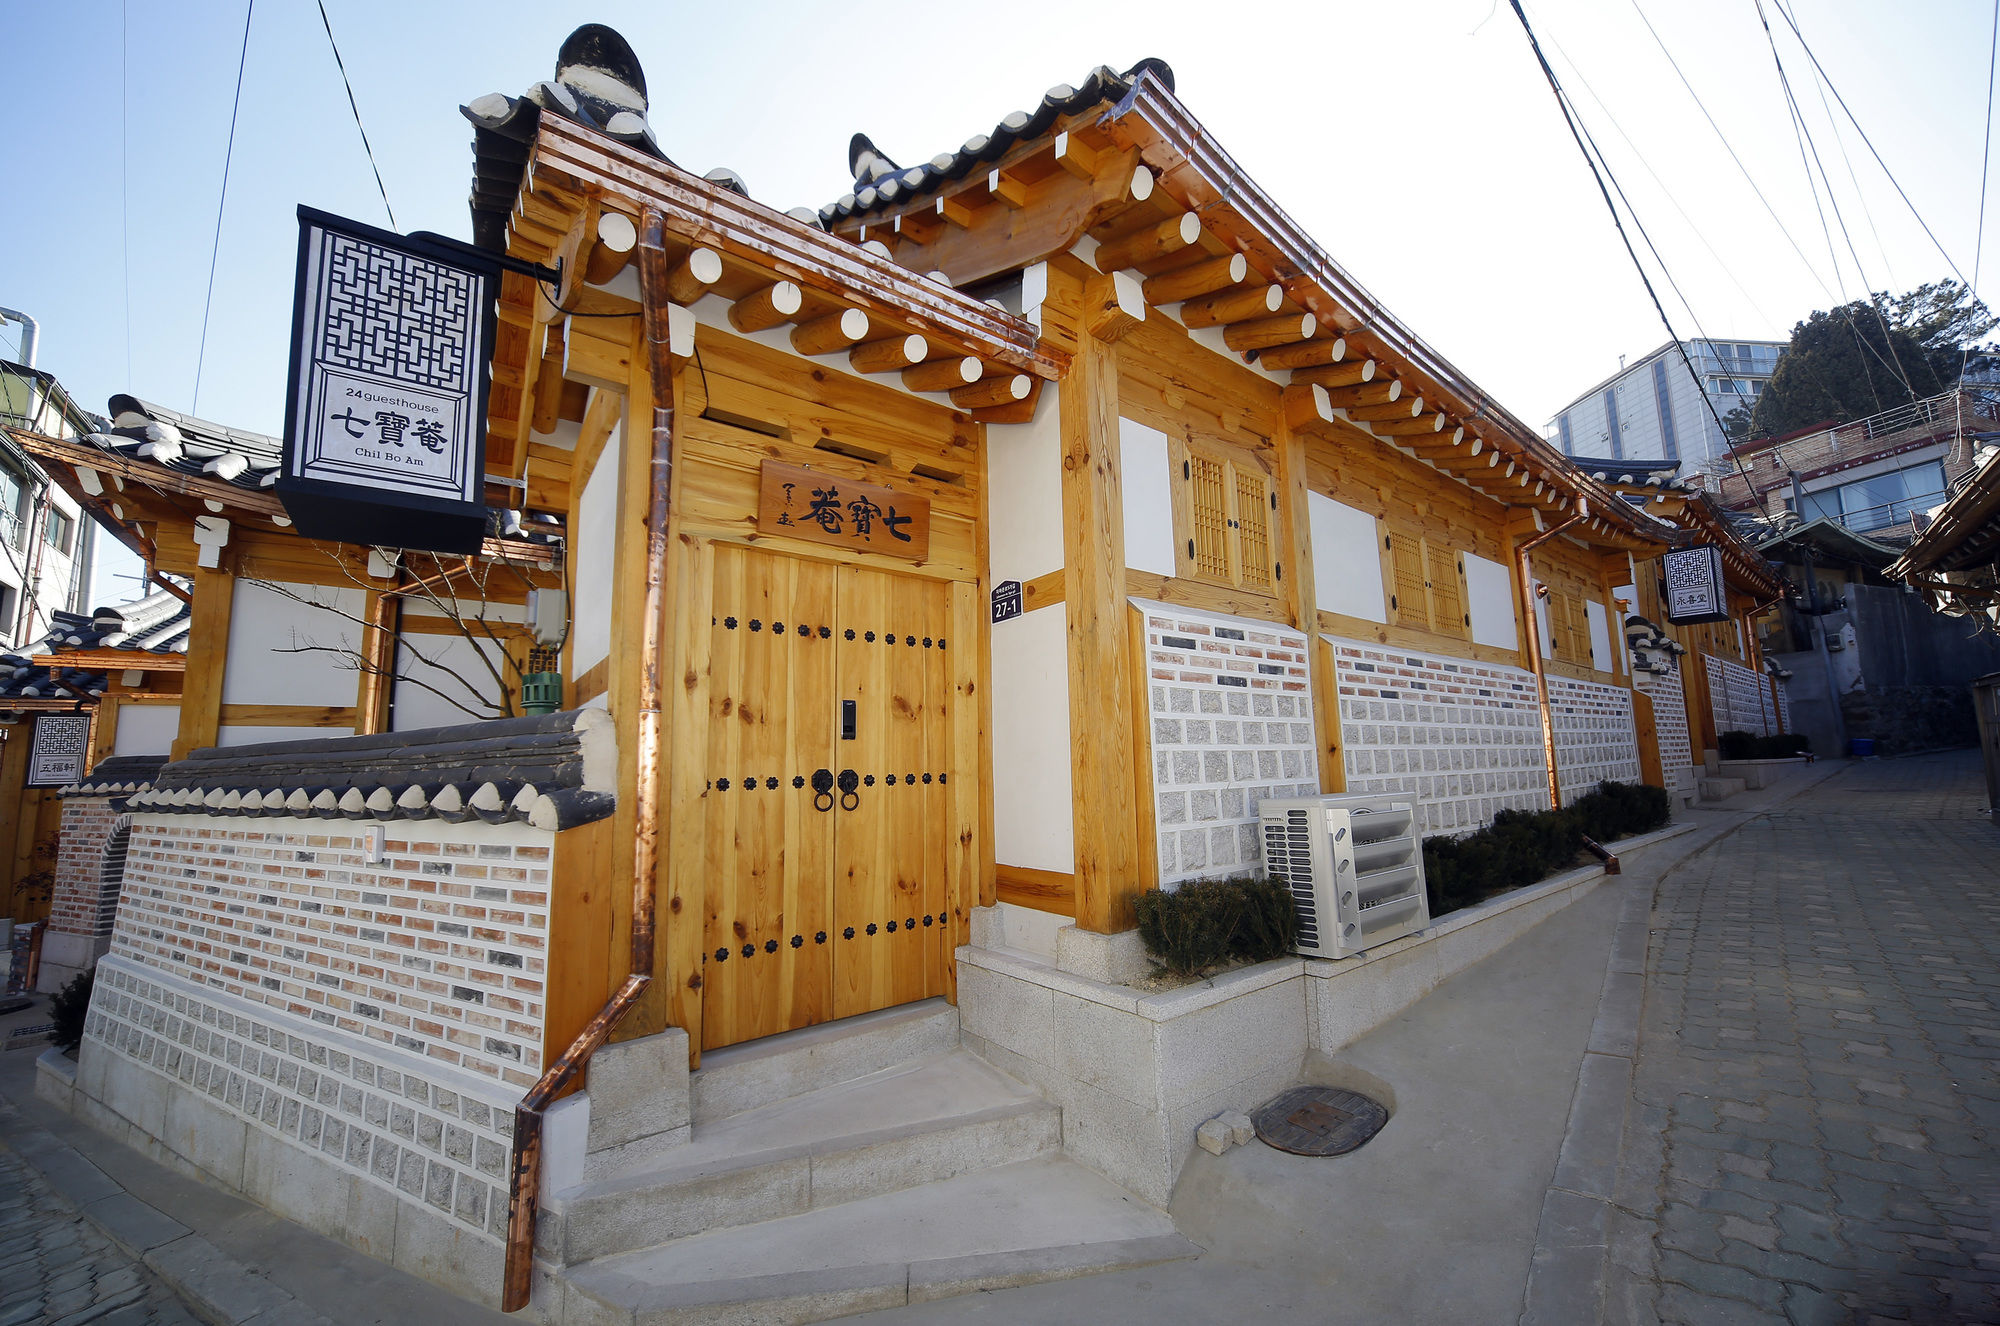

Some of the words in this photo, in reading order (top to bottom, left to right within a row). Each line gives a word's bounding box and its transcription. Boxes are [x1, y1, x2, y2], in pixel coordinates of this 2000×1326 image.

[355, 447, 381, 459] Chil
[385, 452, 401, 462] Bo
[405, 456, 424, 466] Am
[995, 598, 1016, 618] 27-1
